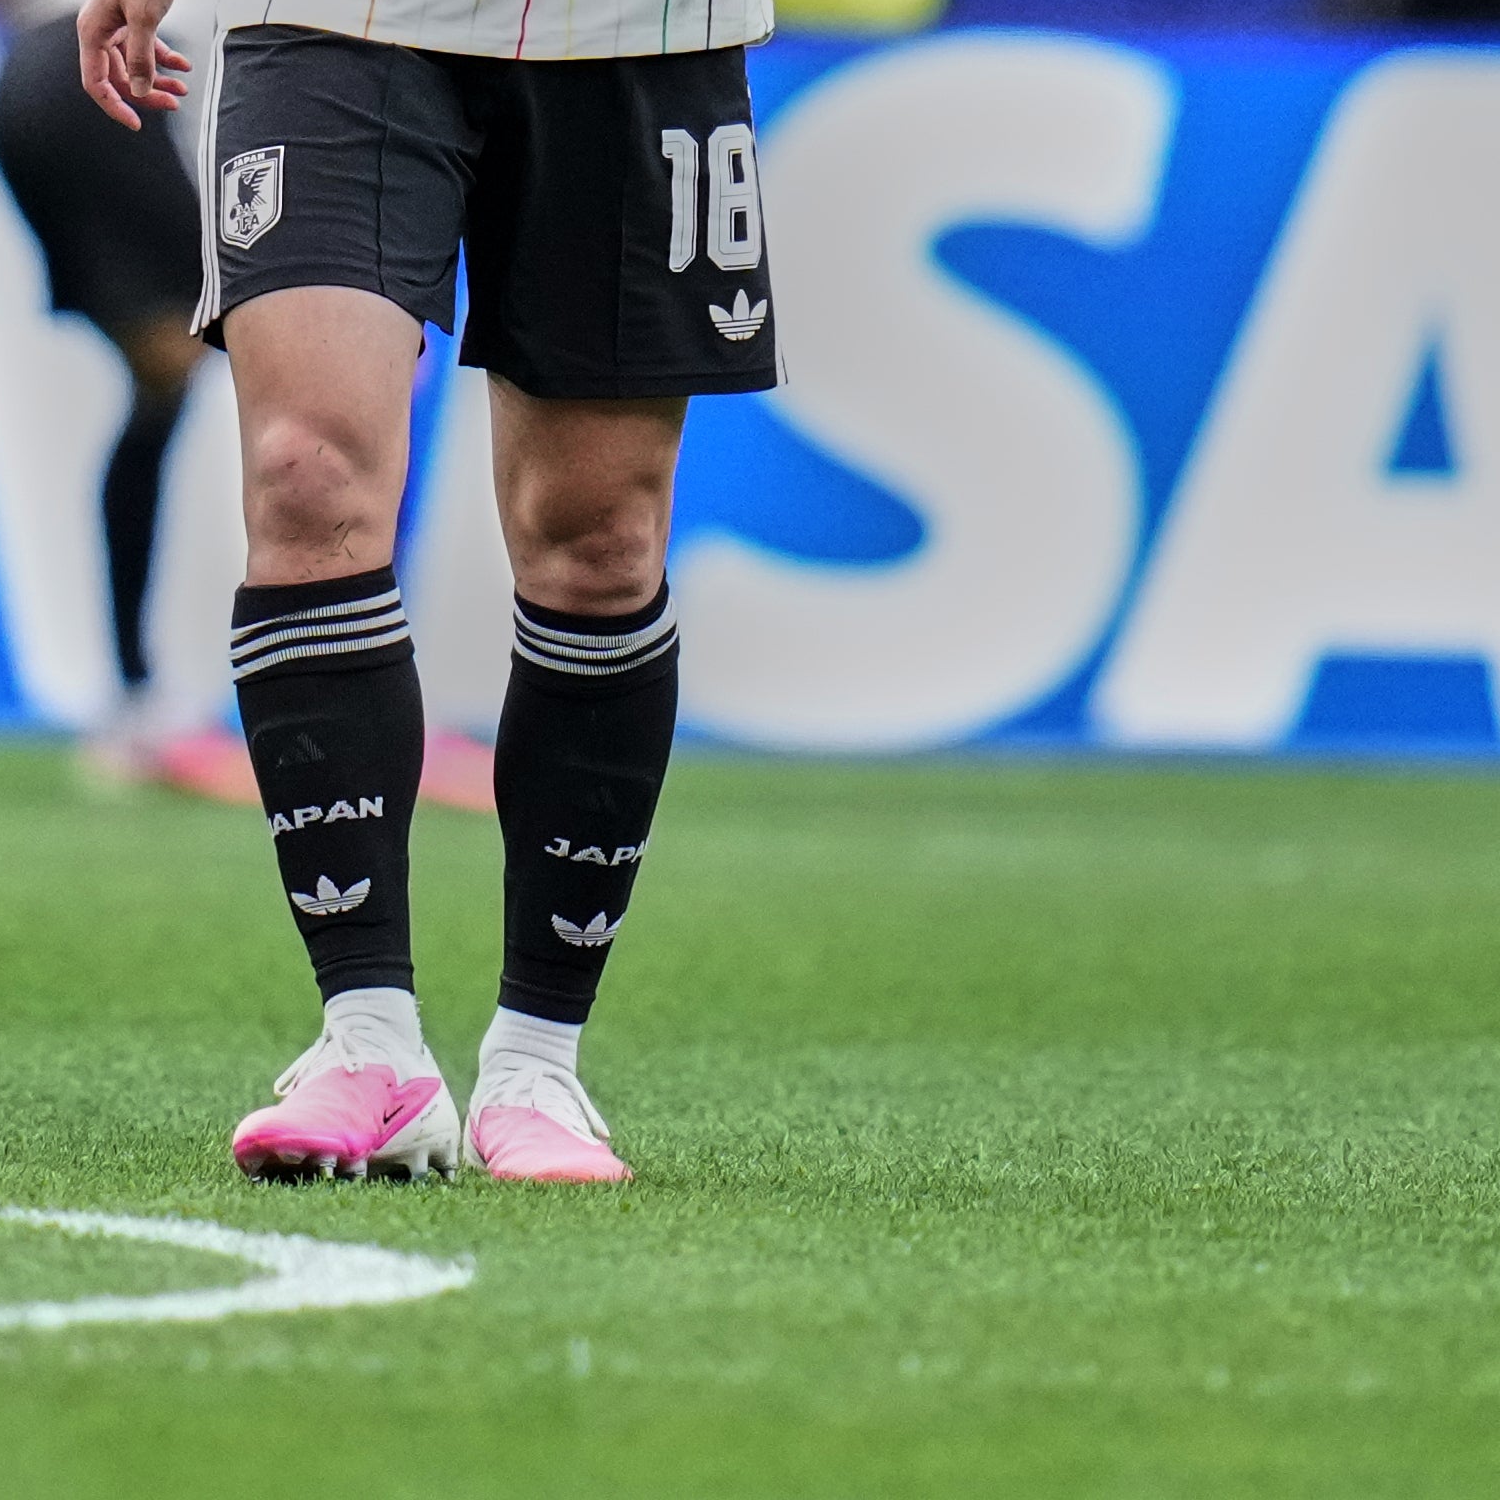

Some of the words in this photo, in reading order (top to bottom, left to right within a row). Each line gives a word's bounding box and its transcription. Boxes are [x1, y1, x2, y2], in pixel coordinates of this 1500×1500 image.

[233, 152, 266, 170] JAPAN
[661, 123, 762, 272] 18
[234, 213, 260, 234] JFA
[267, 796, 383, 841] APAN
[544, 837, 651, 867] JAPA
